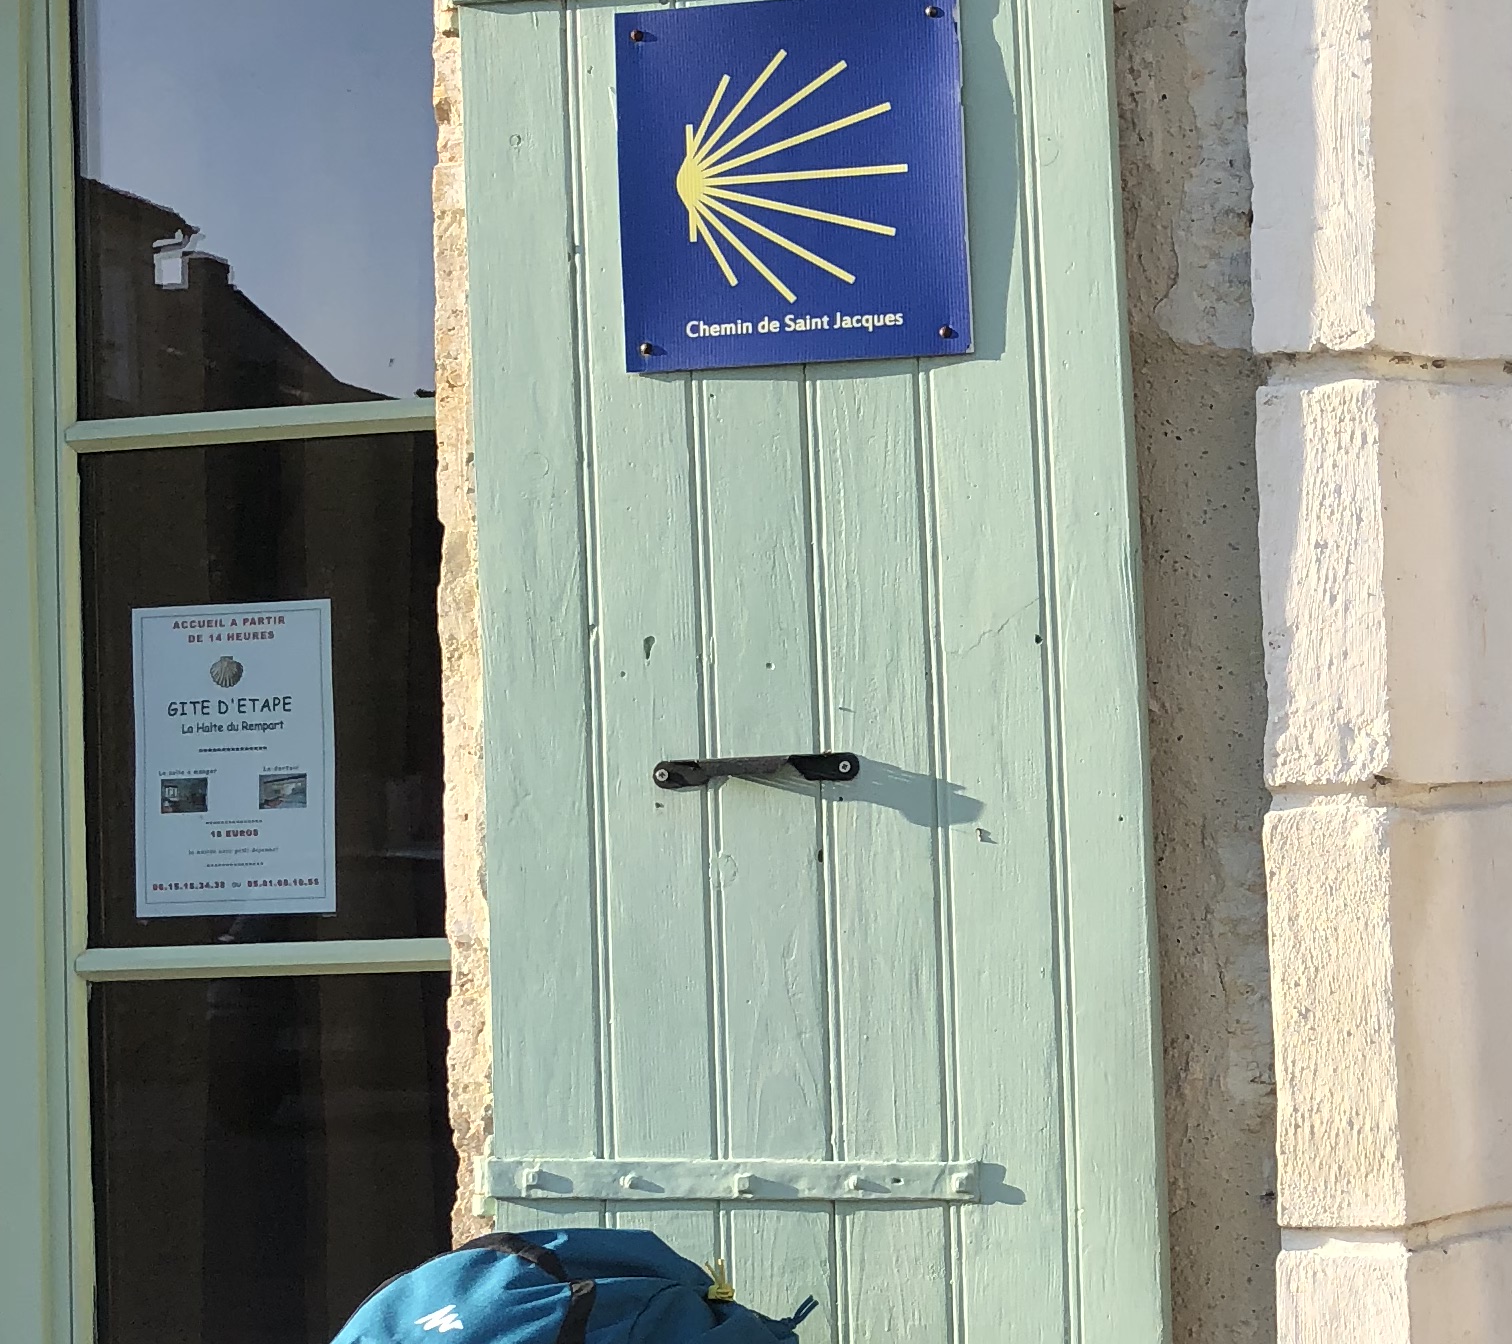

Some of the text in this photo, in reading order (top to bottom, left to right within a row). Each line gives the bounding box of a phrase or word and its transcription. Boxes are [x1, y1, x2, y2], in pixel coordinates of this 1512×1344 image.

[685, 311, 904, 339] Chemin de Saint Jacques
[172, 615, 286, 630] ACCUEIL A PARTIR
[187, 630, 275, 643] DE 14 HEURES
[167, 696, 292, 717] GITE D'ETAPE
[181, 720, 284, 735] La Halte du Rempart
[225, 828, 259, 838] EUROS
